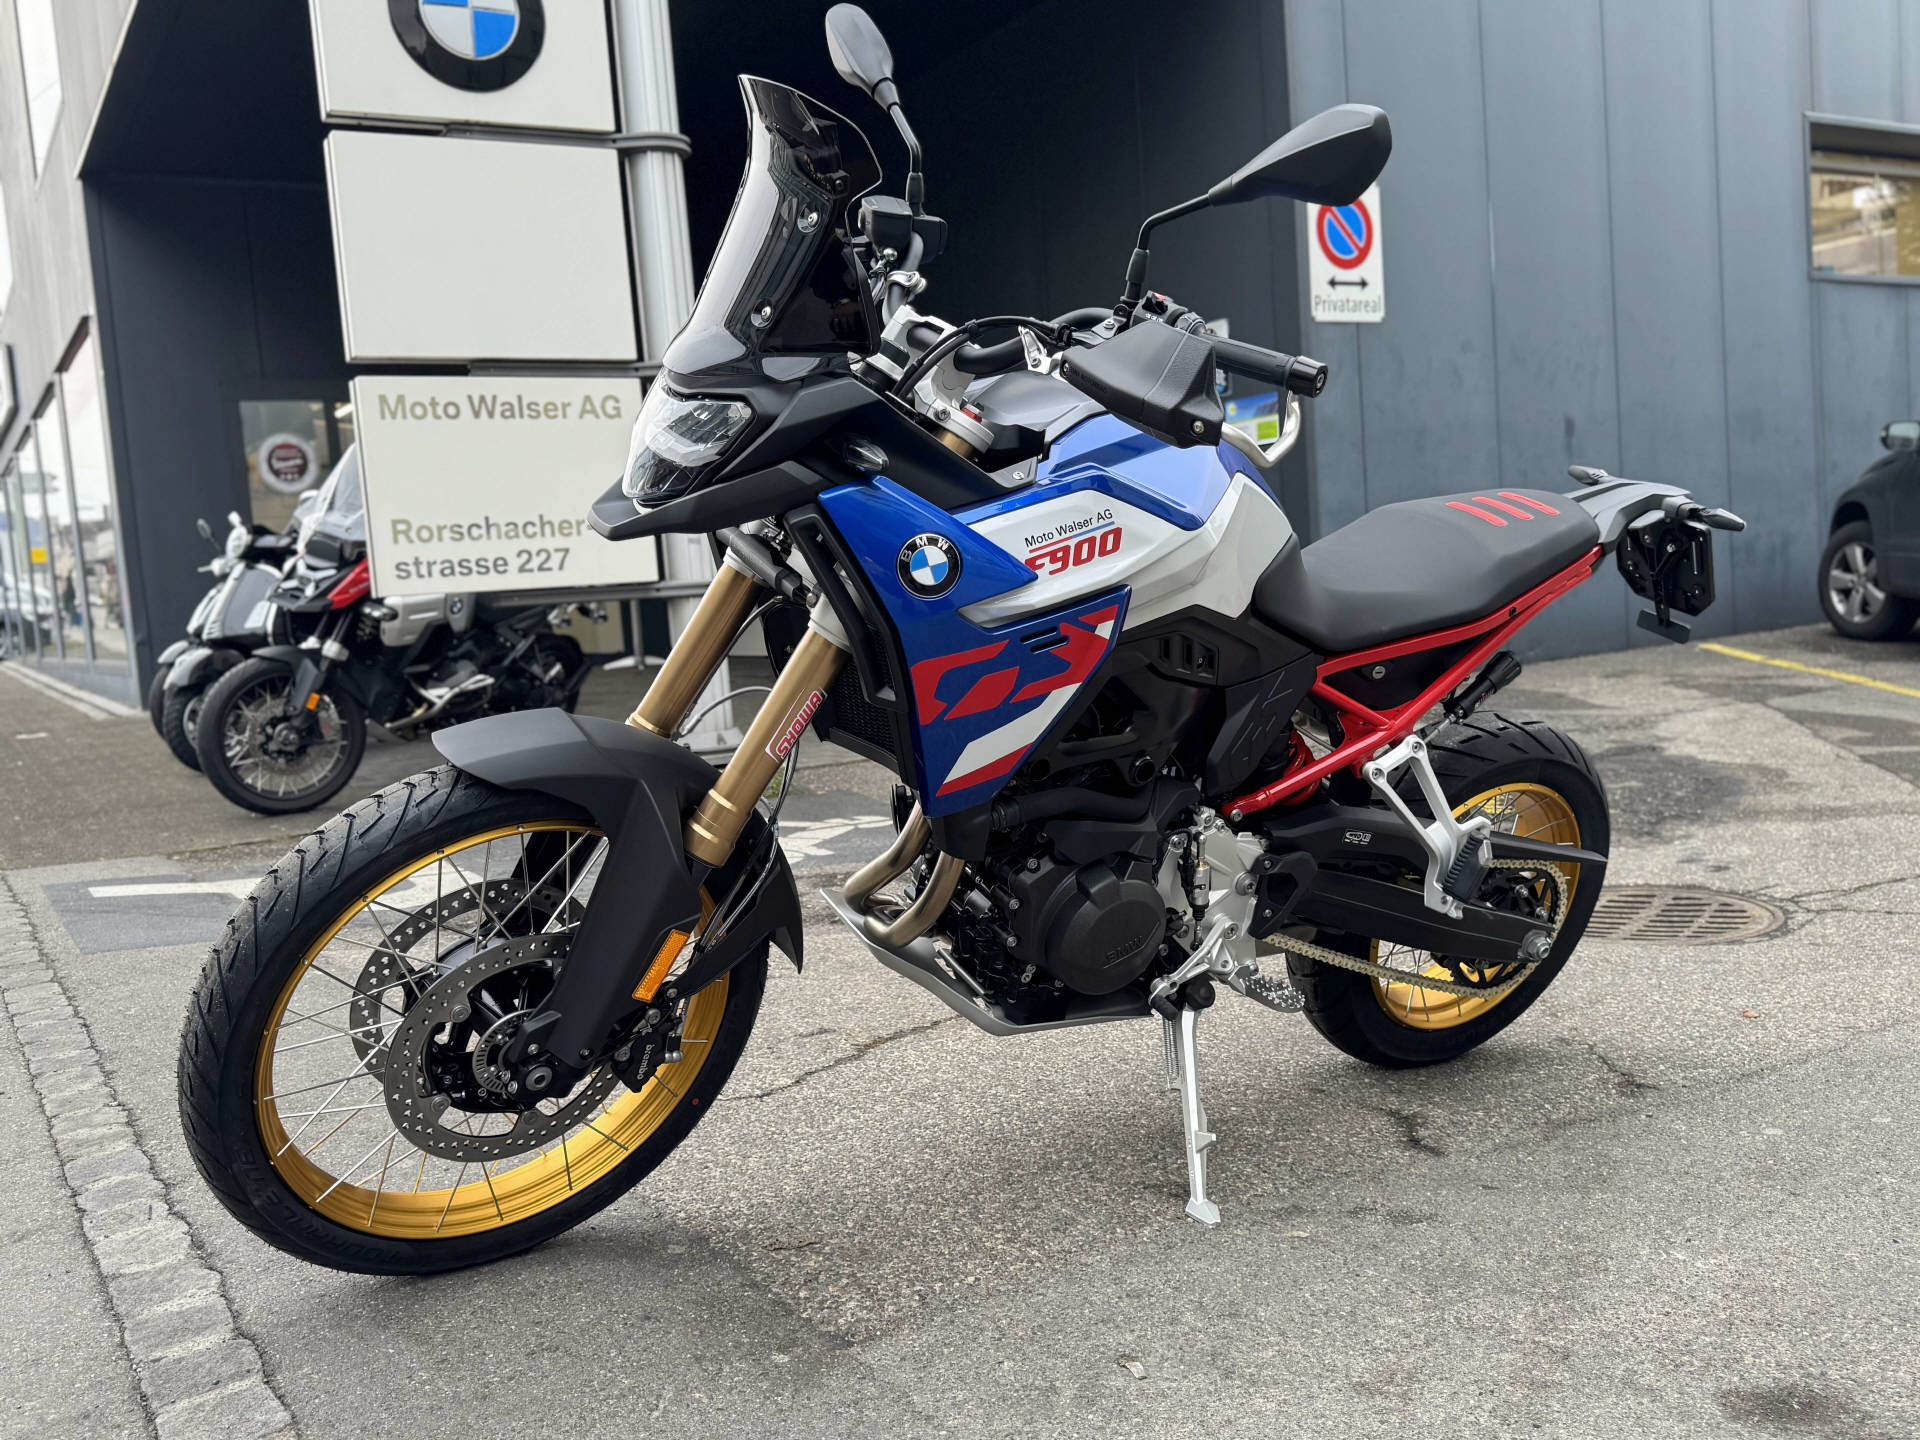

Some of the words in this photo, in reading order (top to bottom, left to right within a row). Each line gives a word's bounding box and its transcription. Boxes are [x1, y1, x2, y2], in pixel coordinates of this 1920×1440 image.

[1313, 295, 1382, 313] Privatareal
[378, 394, 461, 420] Moto
[467, 394, 571, 420] Walser
[578, 393, 623, 420] AG
[1024, 531, 1054, 548] Moto
[1055, 516, 1094, 537] Walser
[1096, 508, 1113, 524] AG
[394, 556, 509, 581] strasse
[516, 547, 571, 574] 227
[900, 535, 950, 563] BMW
[1024, 526, 1123, 576] F900
[776, 690, 823, 759] SHOWA
[636, 1044, 656, 1080] brembo
